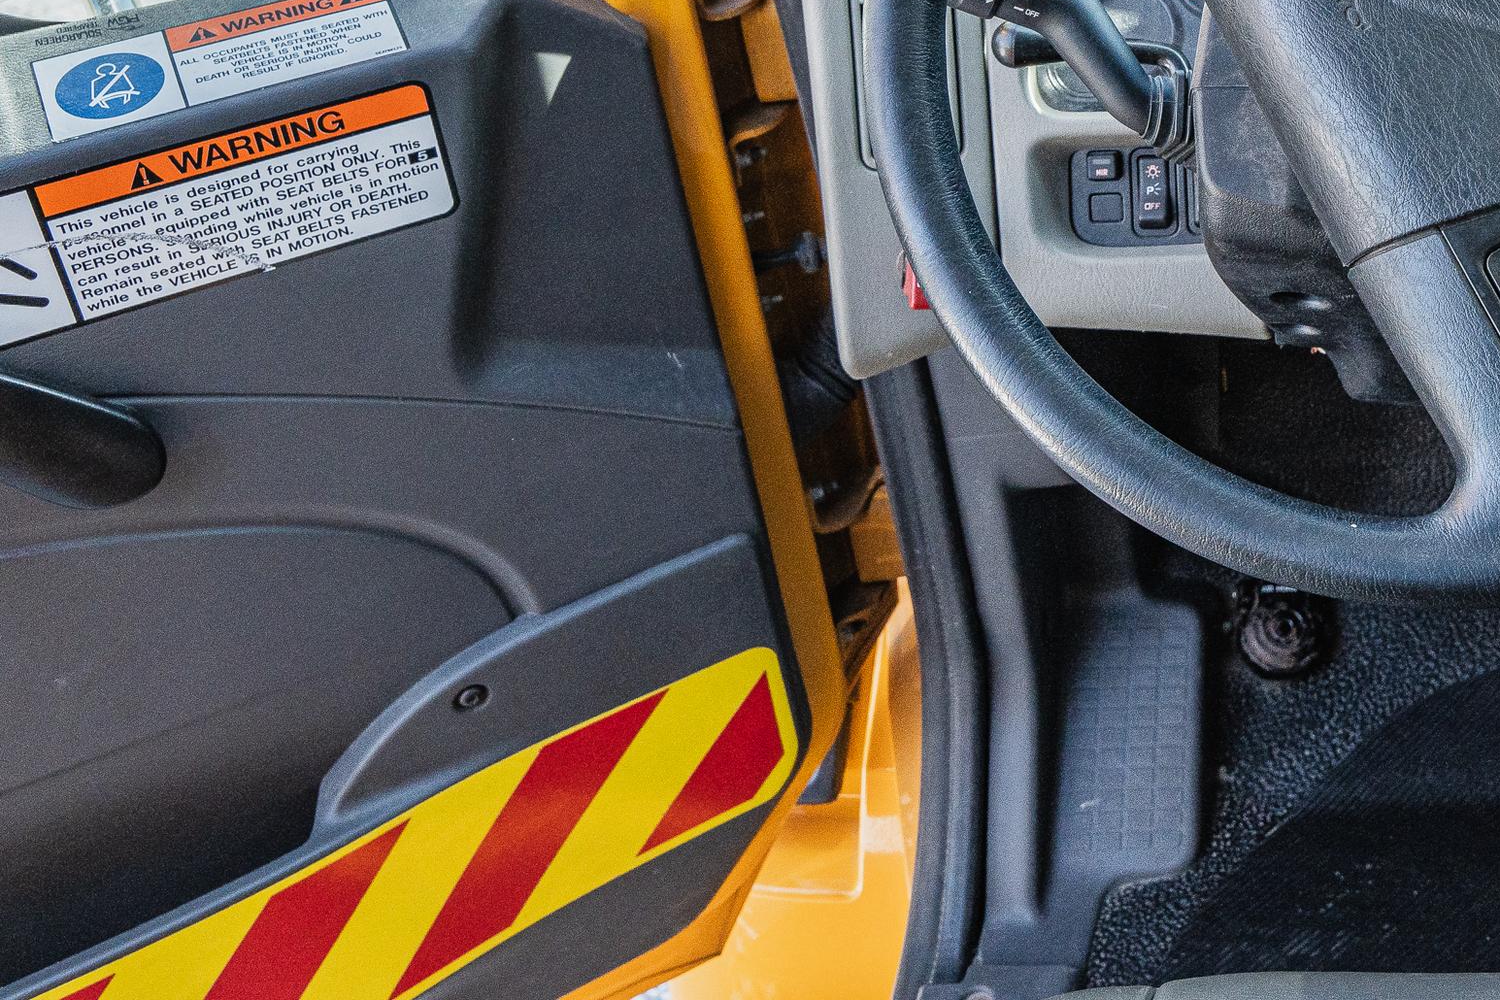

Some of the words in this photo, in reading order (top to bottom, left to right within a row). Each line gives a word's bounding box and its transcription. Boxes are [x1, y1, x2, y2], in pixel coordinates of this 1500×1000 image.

[180, 56, 199, 66] ALL
[203, 40, 266, 61] OCCUPANTS
[271, 32, 299, 44] MUST
[303, 25, 318, 35] BE
[321, 17, 359, 30] SEATED
[363, 10, 387, 20] WITH
[213, 48, 271, 65] SEATBELTS
[275, 32, 327, 49] FASTENED
[331, 23, 361, 36] WHEN
[1025, 9, 1040, 18] OFF
[196, 71, 230, 84] DEATH
[234, 64, 250, 73] OR
[254, 53, 300, 68] SERIOUS
[304, 43, 339, 56] INJURY
[347, 32, 382, 45] COULD
[232, 53, 275, 68] VEHICLE
[307, 34, 349, 48] MOTION.
[242, 65, 280, 79] RESULT
[298, 49, 347, 64] IGNORED.
[168, 111, 345, 174] WARNING
[56, 218, 93, 235] This
[100, 200, 158, 223] vehicle
[187, 169, 260, 198] designed
[267, 162, 289, 176] for
[296, 144, 359, 169] carrying
[68, 237, 127, 260] vehicle
[156, 207, 230, 237] equipped
[237, 196, 269, 212] with
[276, 182, 315, 201] SEAT
[322, 167, 369, 188] BELTS
[376, 156, 407, 172] FOR
[153, 212, 167, 223] in
[191, 185, 253, 211] SEATED
[260, 163, 336, 192] POSITION
[342, 150, 385, 168] ONLY.
[390, 140, 421, 154] This
[1144, 203, 1160, 211] OFF
[71, 242, 159, 274] PERSONS.
[244, 206, 288, 224] while
[290, 189, 343, 211] vehicle
[370, 177, 382, 188] in
[388, 162, 439, 183] motion
[78, 271, 108, 287] can
[115, 256, 161, 276] result
[168, 250, 182, 261] in
[268, 207, 322, 232] INJURY
[330, 200, 352, 213] OR
[358, 182, 411, 205] DEATH.
[80, 276, 143, 300] Remain
[150, 257, 205, 280] seated
[251, 230, 290, 250] SEAT
[298, 216, 345, 236] BELTS
[351, 190, 429, 220] FASTENED
[87, 292, 129, 312] while
[136, 283, 163, 297] the
[168, 260, 238, 287] VEHICLE
[266, 244, 283, 258] IN
[289, 226, 354, 252] MOTION.
